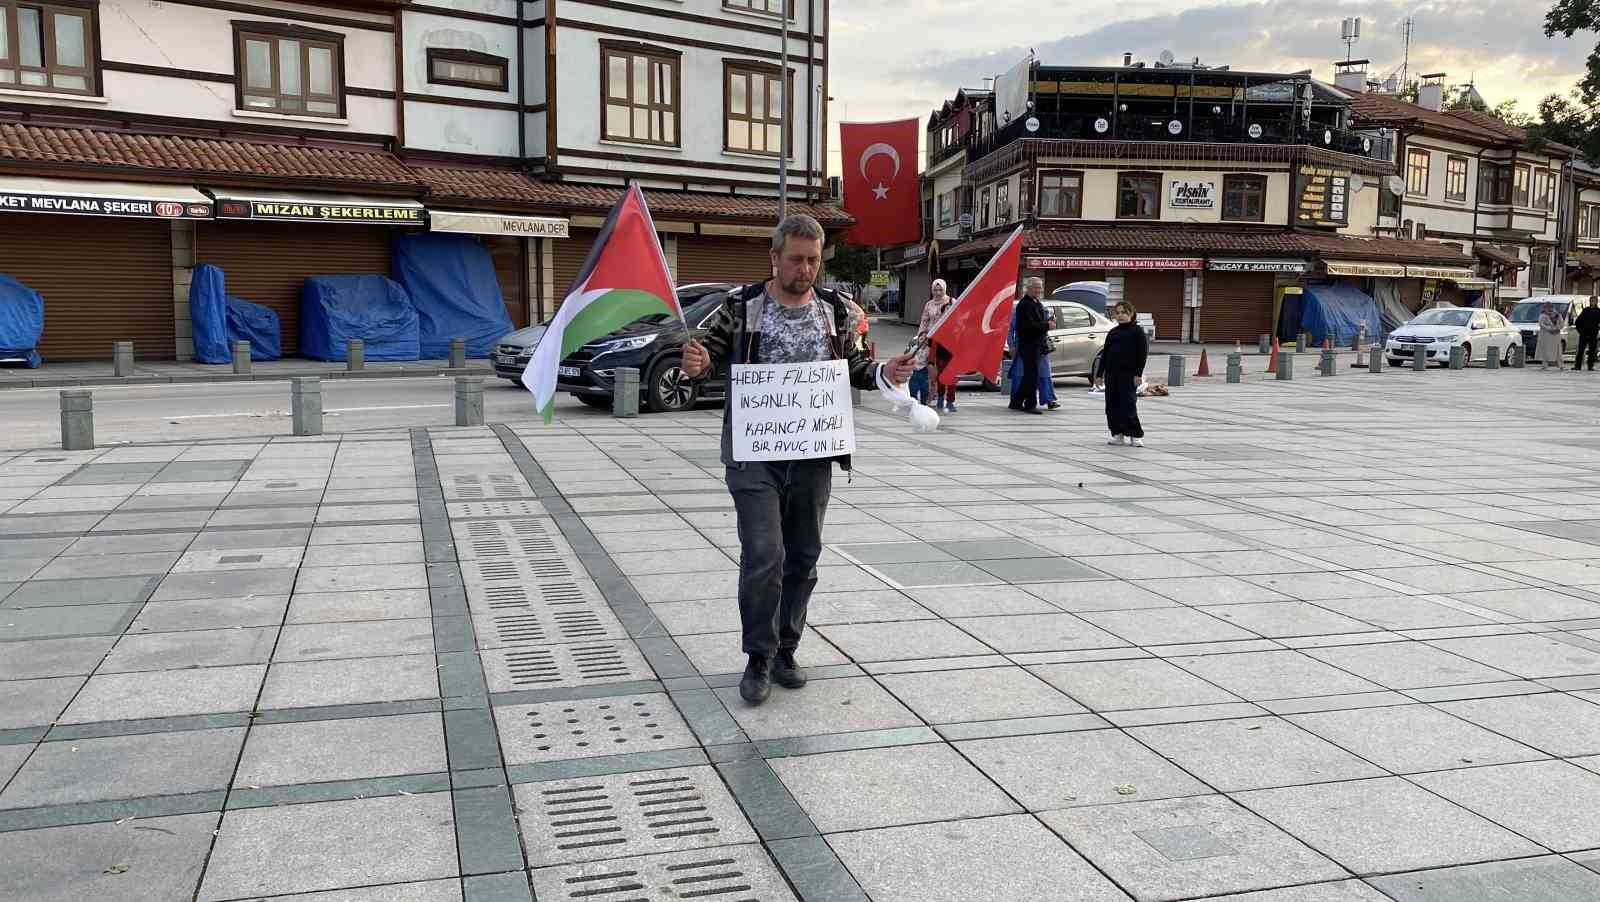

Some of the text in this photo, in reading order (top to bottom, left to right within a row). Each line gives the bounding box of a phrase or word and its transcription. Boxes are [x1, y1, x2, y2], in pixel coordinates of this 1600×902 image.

[31, 197, 100, 211] MEVLANA
[103, 201, 152, 214] ŞEKERİ
[257, 204, 314, 216] MİZAN
[320, 206, 418, 219] ŞEKERLEME
[503, 220, 546, 233] MEVLANA
[745, 418, 807, 437] KARINCA
[774, 439, 809, 455] AVUÇ
[813, 439, 828, 453] UN
